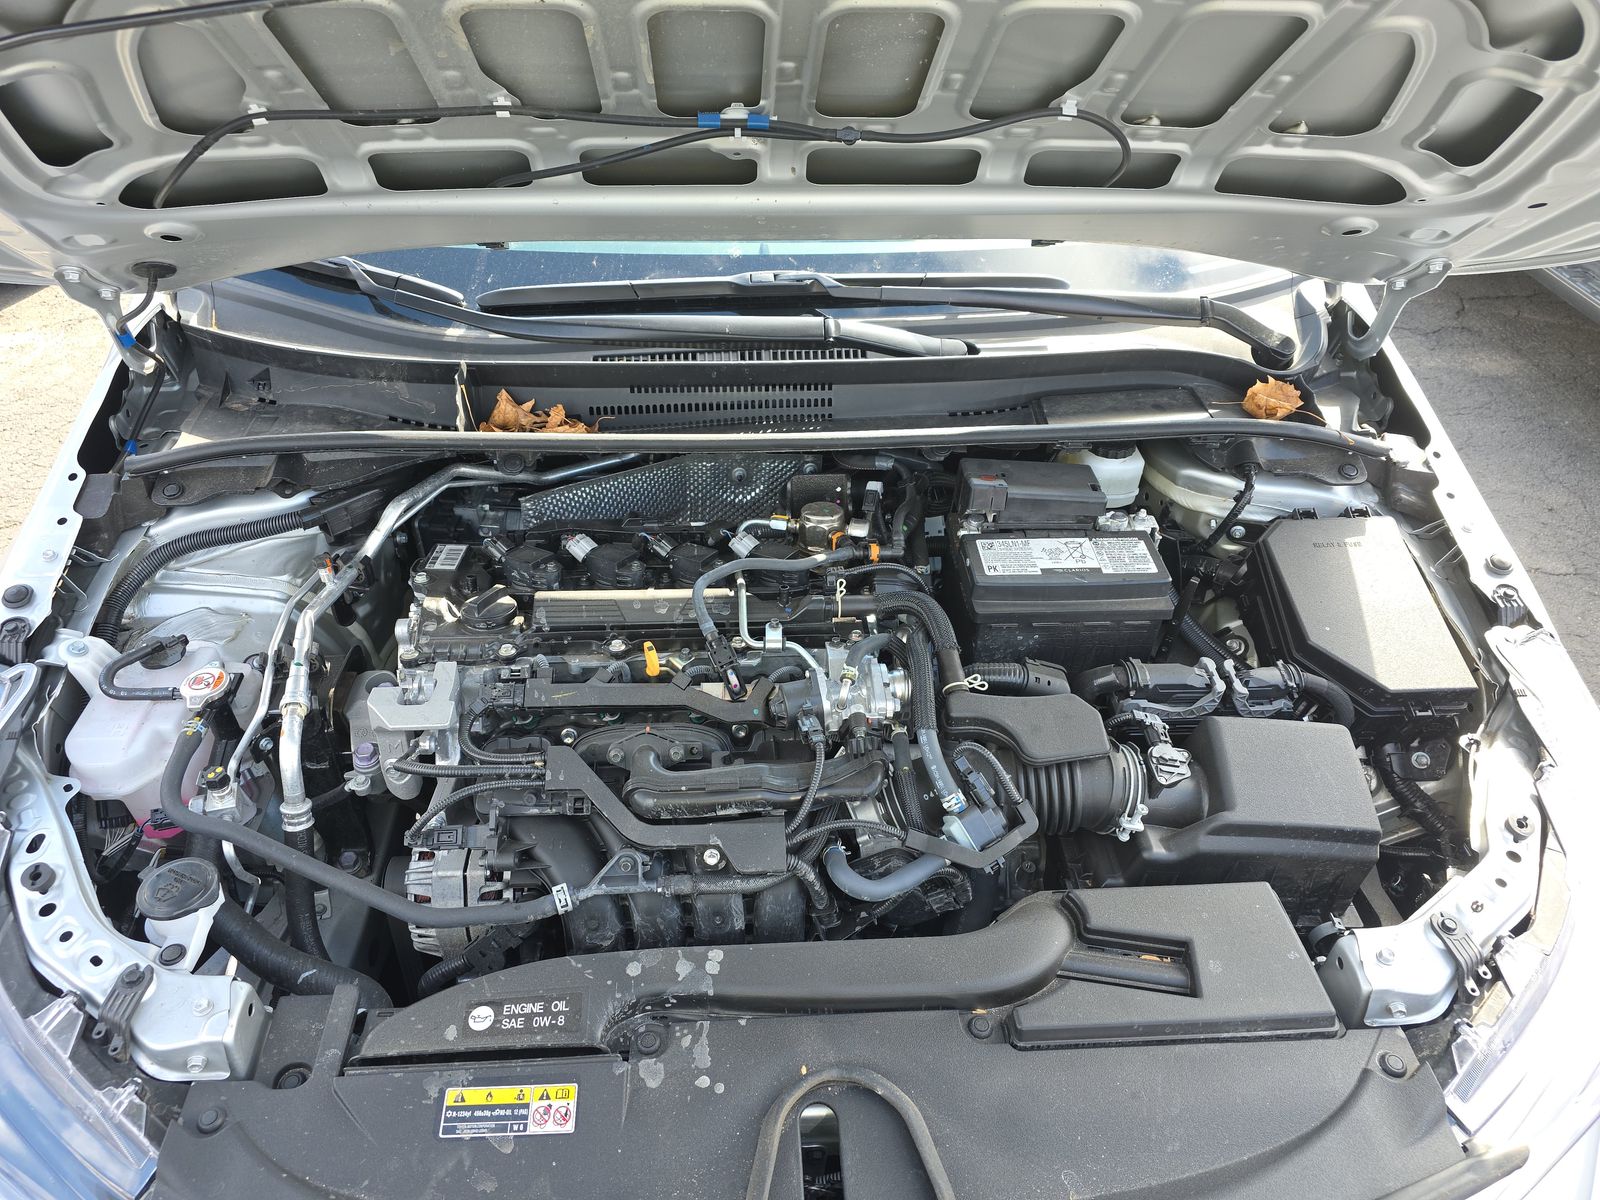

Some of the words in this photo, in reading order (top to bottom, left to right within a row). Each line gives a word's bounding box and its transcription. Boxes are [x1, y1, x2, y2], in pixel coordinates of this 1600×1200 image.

[987, 564, 999, 573] PK
[503, 1001, 545, 1015] ENGINE
[551, 1000, 570, 1012] OIL
[501, 1017, 525, 1030] SAE
[532, 1015, 565, 1028] 0W-8
